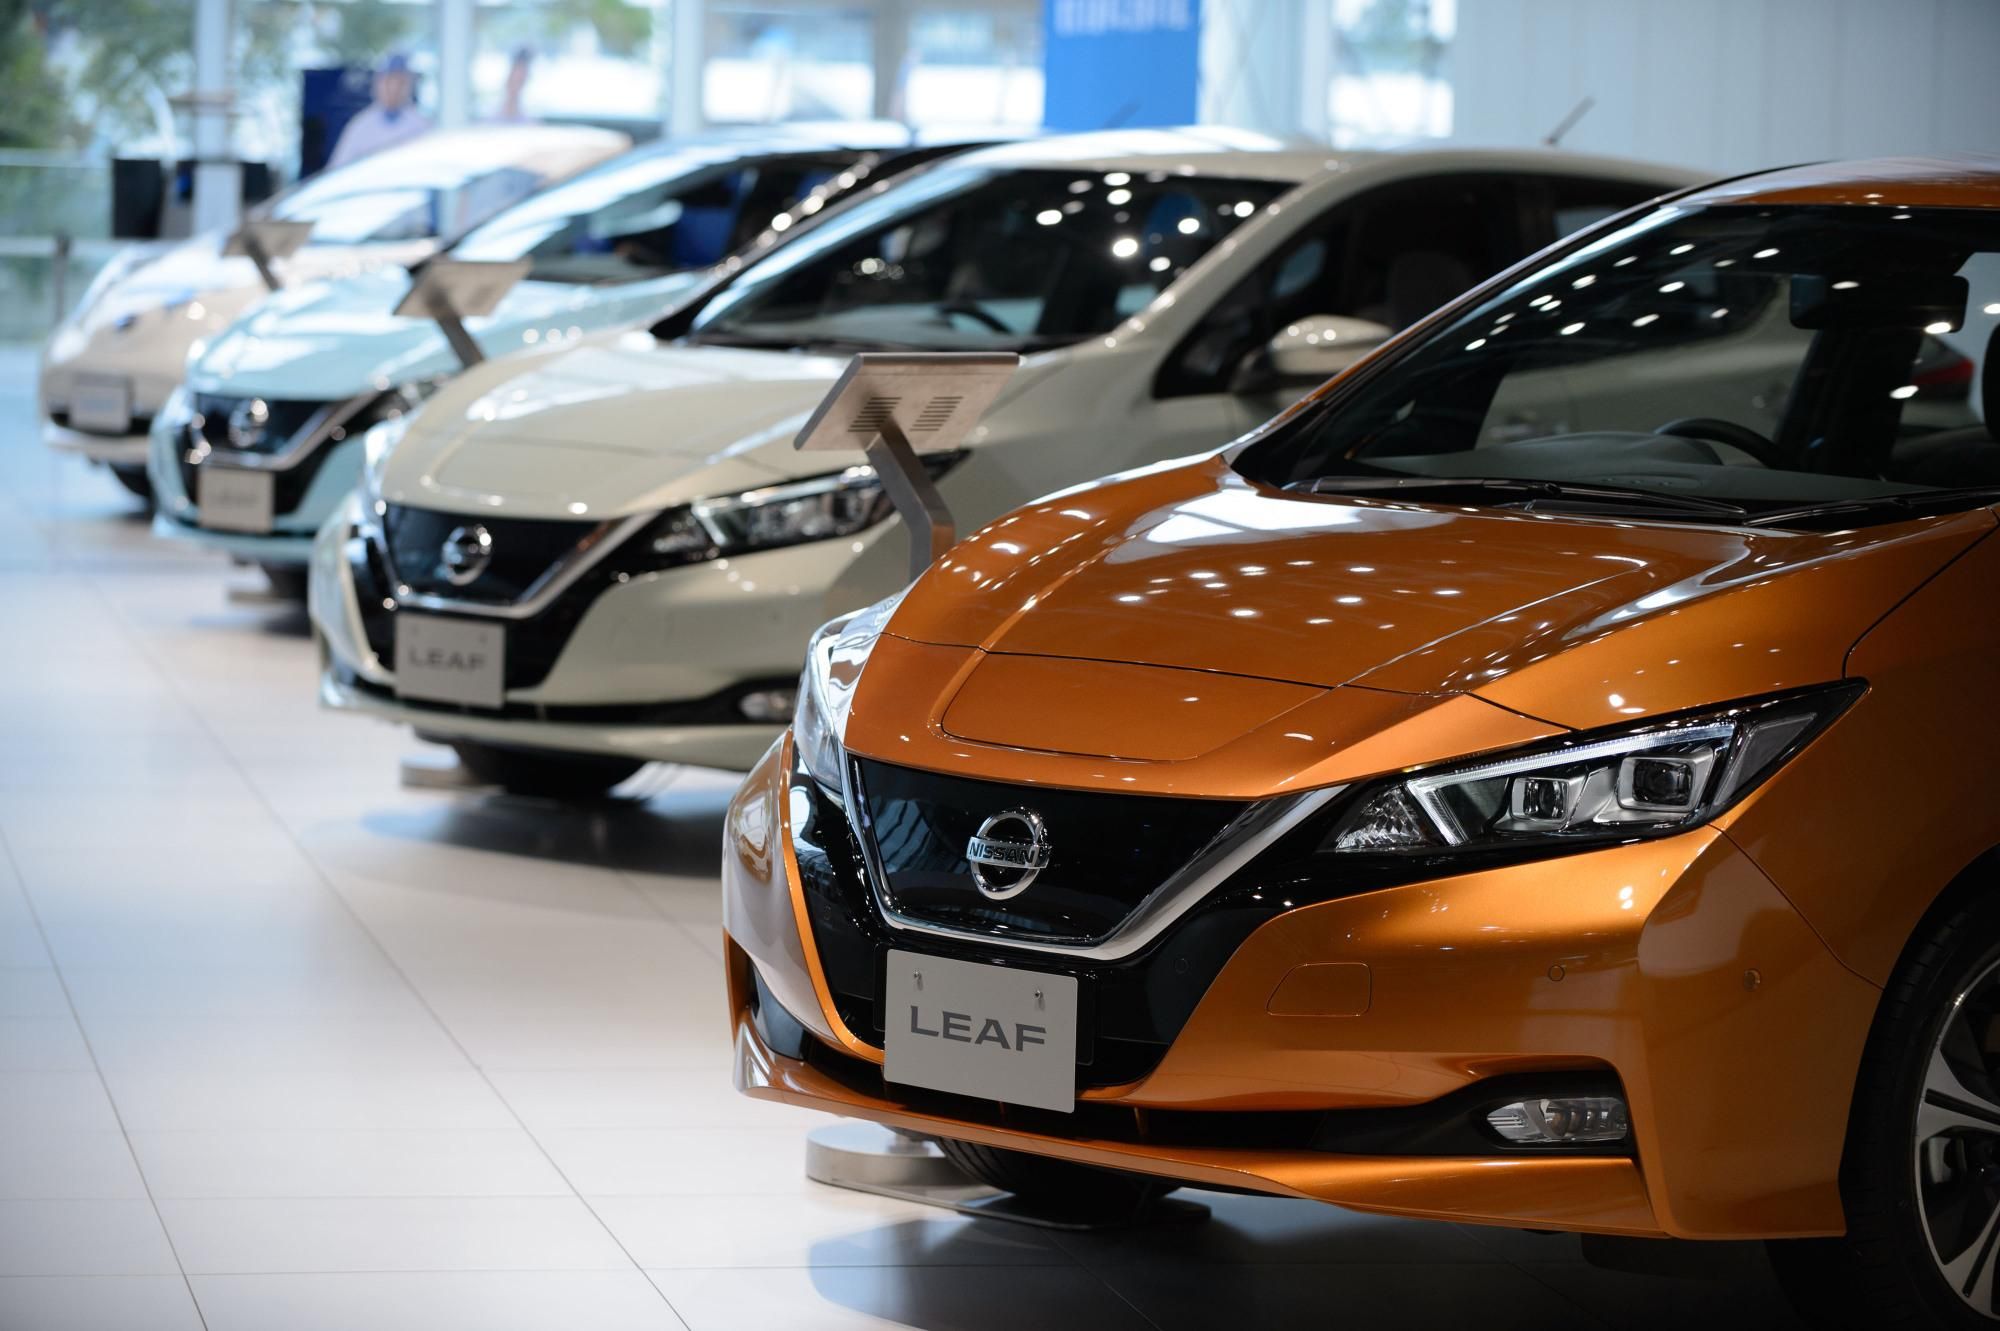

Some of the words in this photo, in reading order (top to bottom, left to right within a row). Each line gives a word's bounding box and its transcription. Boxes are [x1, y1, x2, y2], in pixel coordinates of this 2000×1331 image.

[408, 646, 485, 673] LEAF
[969, 842, 1036, 865] NISSAN
[911, 1005, 1046, 1051] LEAF
